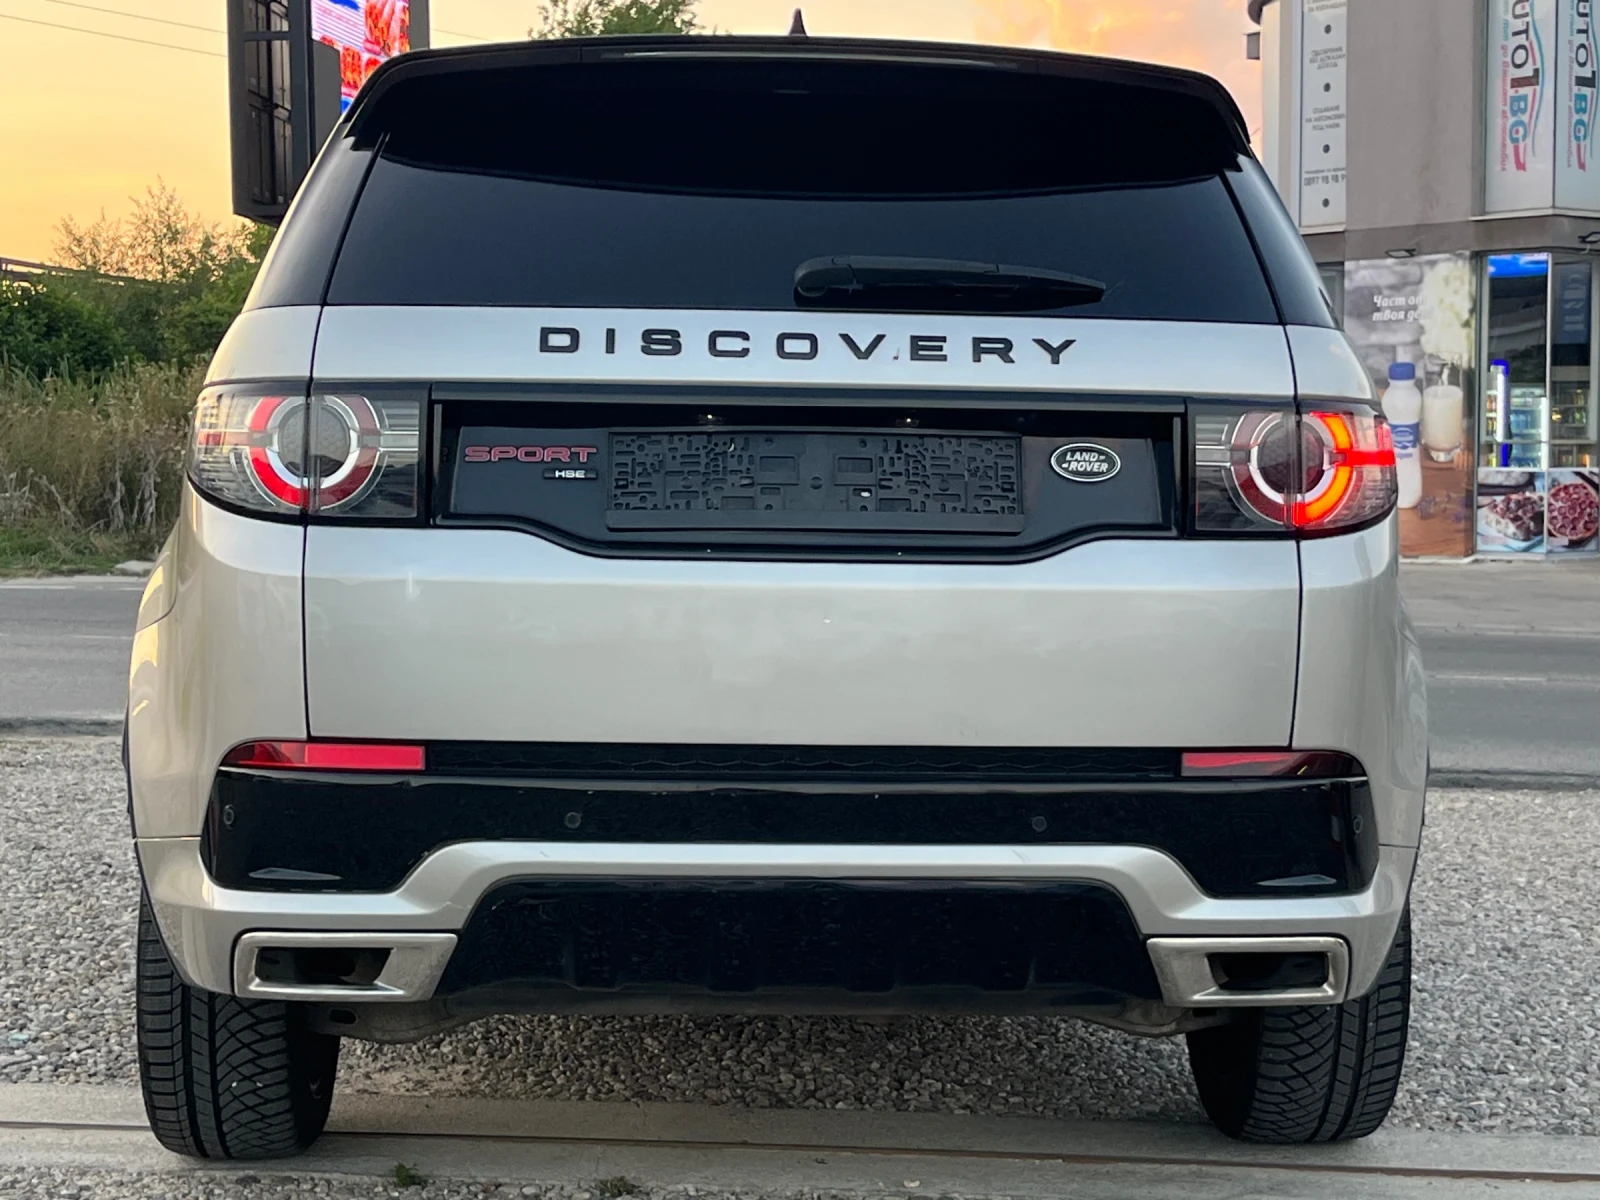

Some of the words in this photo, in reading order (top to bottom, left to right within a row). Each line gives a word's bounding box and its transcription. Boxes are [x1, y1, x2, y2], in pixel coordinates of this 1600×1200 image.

[1373, 295, 1406, 307] Част
[1371, 309, 1405, 321] твоя
[539, 326, 1077, 365] DISCOVERY
[464, 445, 597, 463] SPORT
[1065, 451, 1098, 462] LAND
[1068, 461, 1109, 473] ROVER
[555, 469, 586, 479] HSE
